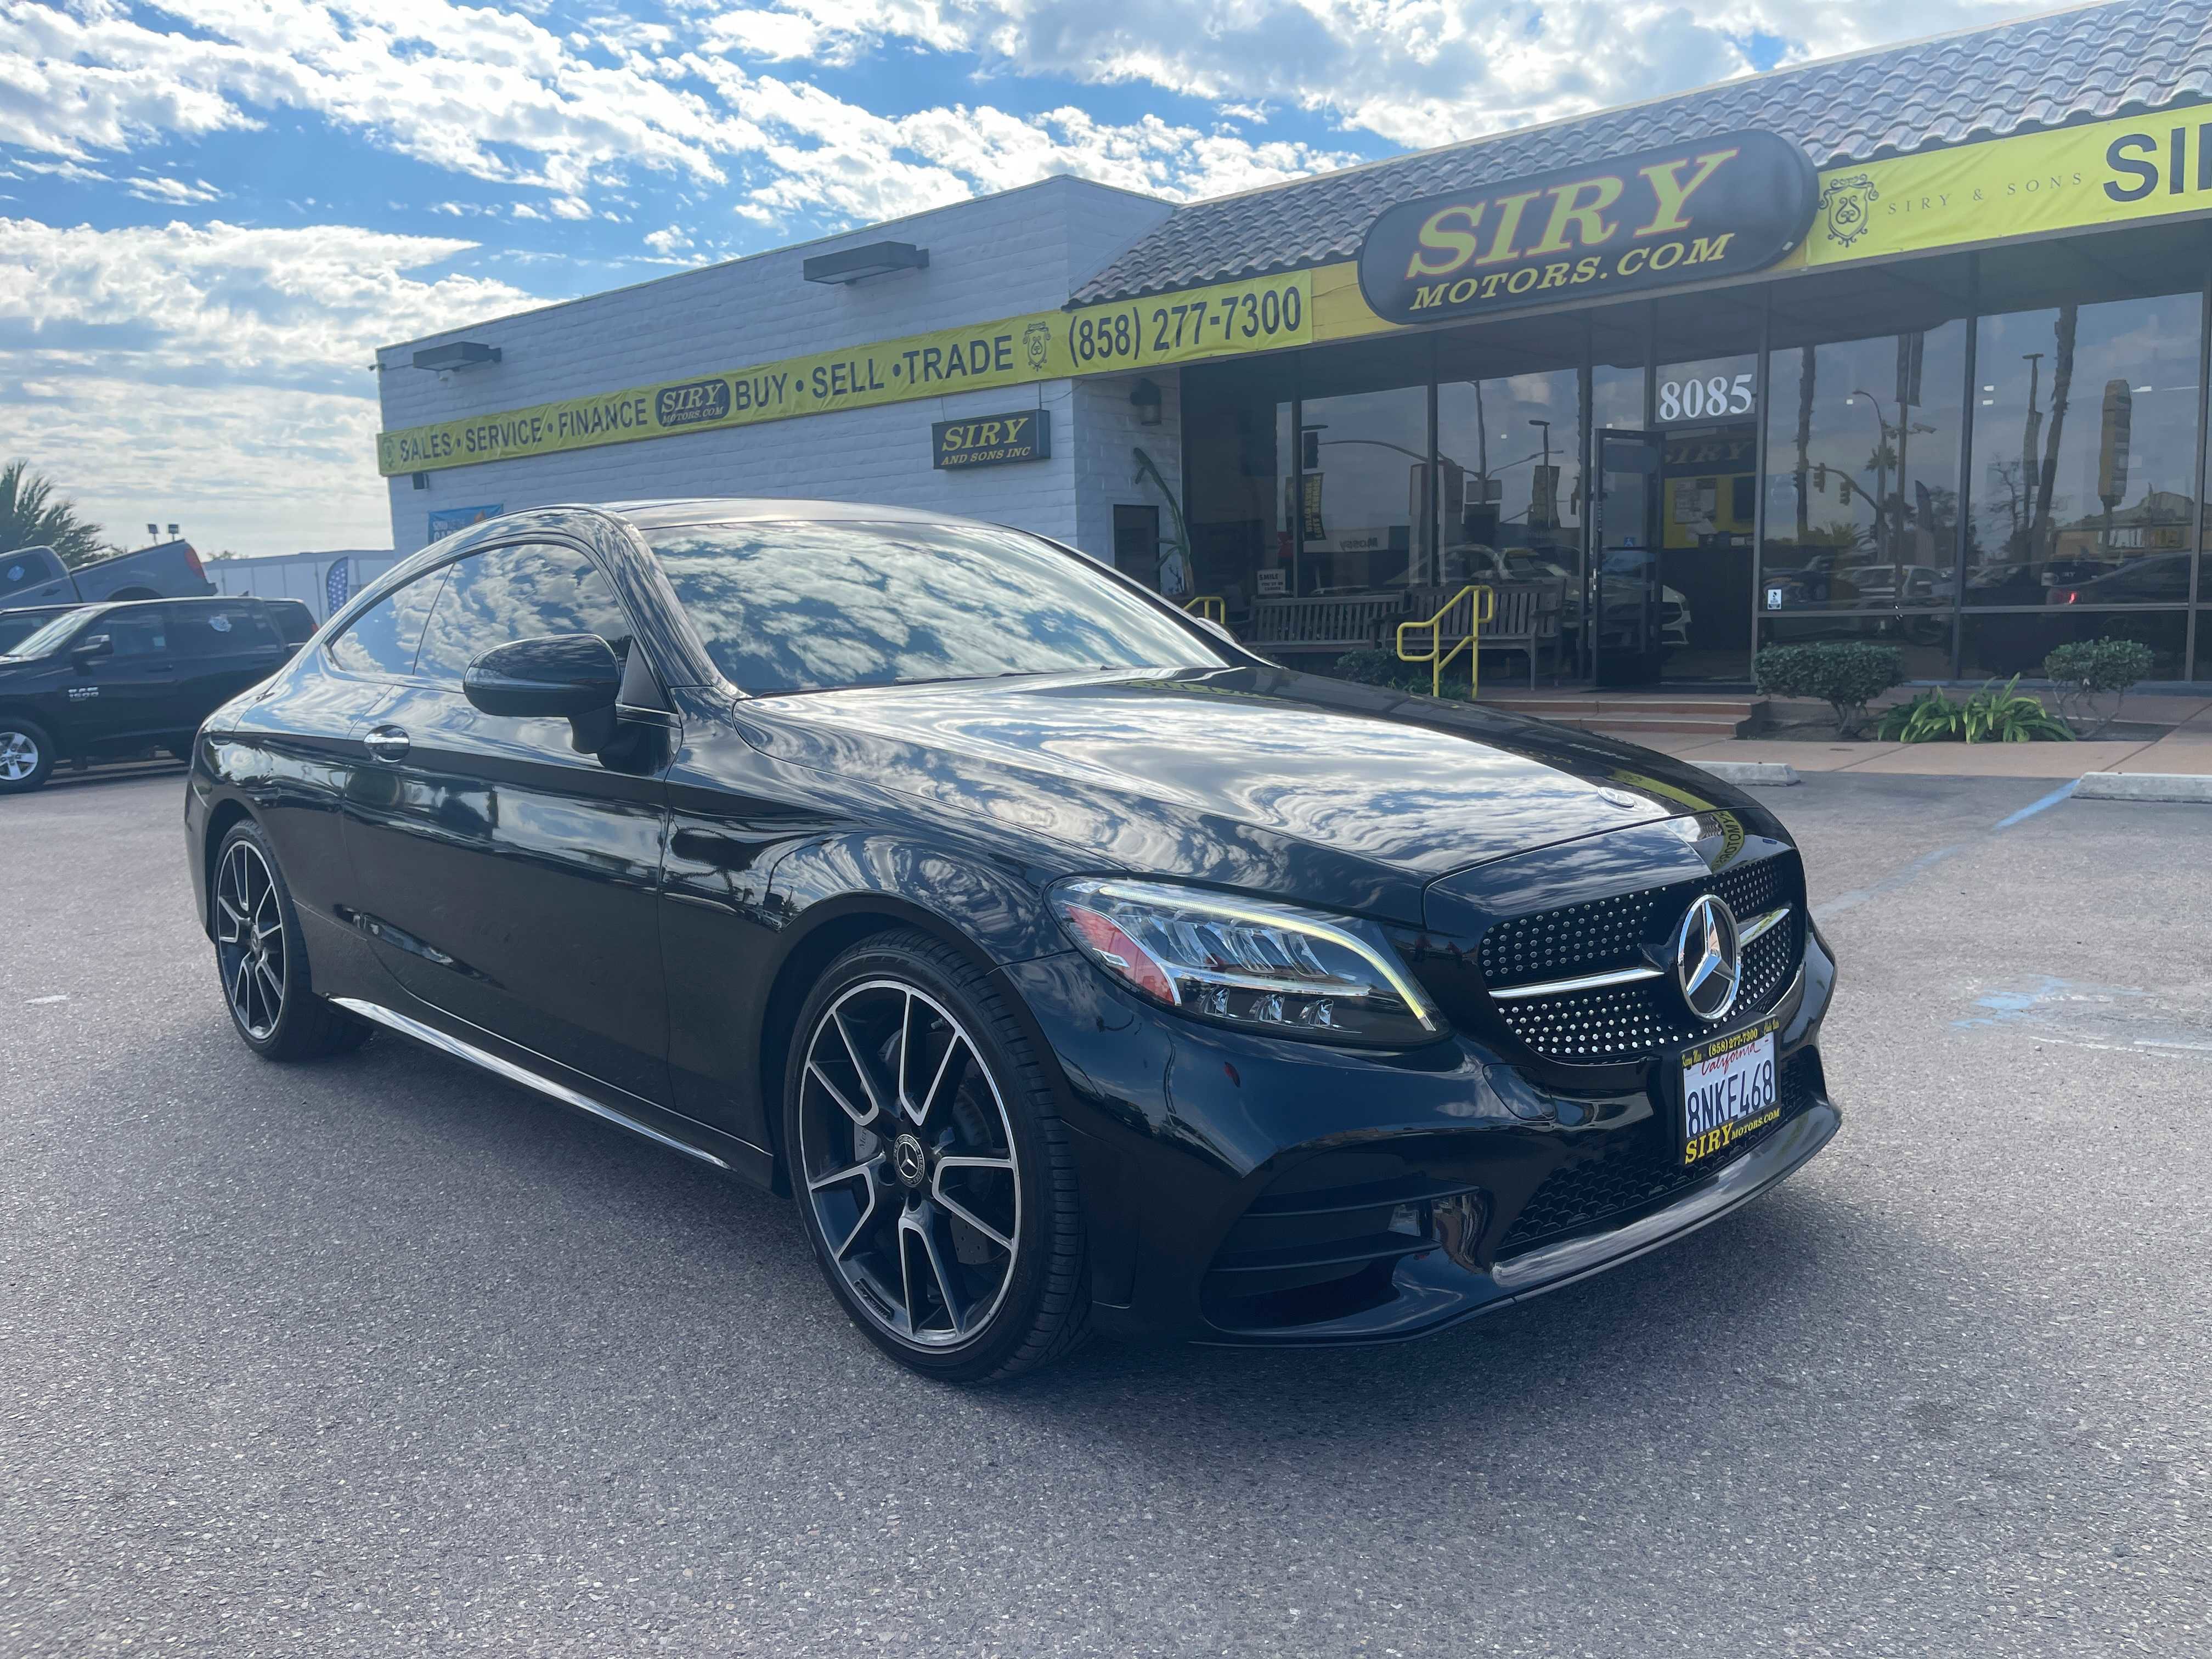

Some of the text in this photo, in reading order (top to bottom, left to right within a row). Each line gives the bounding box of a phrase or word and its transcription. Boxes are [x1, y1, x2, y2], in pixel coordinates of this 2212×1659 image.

[1404, 147, 1740, 280] SIRY
[1889, 172, 2081, 215] SIRY & SONS
[1409, 233, 1735, 311] MOTORS.COM
[1068, 286, 1302, 368] (858) 277-7300
[736, 335, 1014, 411] BUY SELL TRADE
[661, 383, 725, 415] SIRY
[662, 406, 724, 424] MOTORS.COM
[1658, 374, 1753, 421] 8085
[400, 398, 648, 461] SALES SERVICE FINANCE
[941, 417, 1028, 453] SIRY
[941, 445, 1031, 466] AND SONS INC
[1701, 1042, 1761, 1076] California
[1687, 1059, 1773, 1138] 8NKE468
[1685, 1122, 1733, 1164] SIRY
[1731, 1108, 1780, 1138] MOTORS.COM
